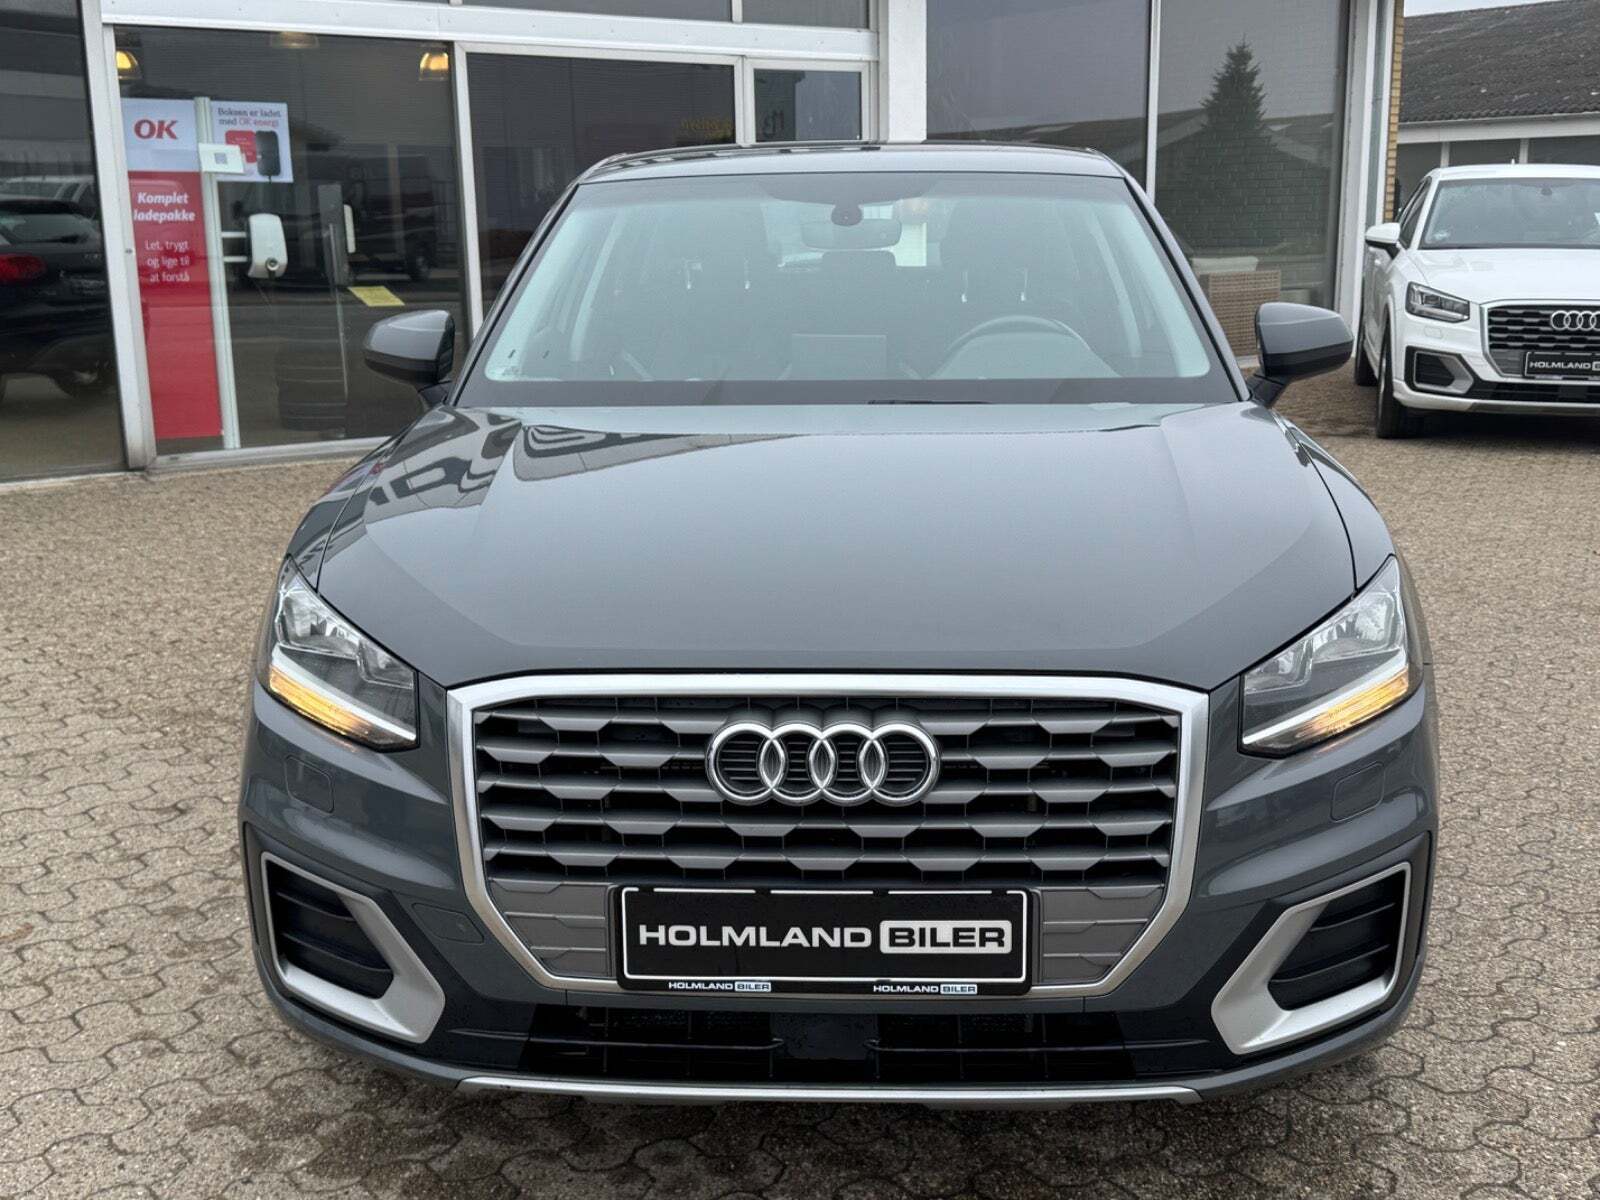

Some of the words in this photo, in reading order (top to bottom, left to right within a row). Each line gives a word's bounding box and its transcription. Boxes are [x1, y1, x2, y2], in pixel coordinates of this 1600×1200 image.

[217, 106, 248, 116] Boksen
[249, 109, 258, 117] er
[260, 108, 281, 118] ladet
[219, 117, 237, 126] med
[239, 118, 252, 126] OK
[253, 119, 279, 128] energi
[134, 119, 178, 140] OK
[137, 191, 189, 207] Komplet
[133, 208, 196, 224] ladepakke
[144, 239, 163, 252] Let,
[165, 240, 189, 253] trygt
[147, 258, 159, 269] og
[161, 256, 178, 269] lige
[180, 256, 190, 266] til
[150, 273, 160, 282] at
[162, 272, 190, 282] forstå
[1530, 361, 1591, 369] HOLMLAND
[638, 923, 873, 949] HOLMLAND
[887, 926, 1006, 949] BILER
[667, 981, 733, 991] HOLMLAND
[736, 982, 771, 992] BILER
[873, 984, 939, 994] HOLMLAND
[941, 985, 977, 995] BILER
